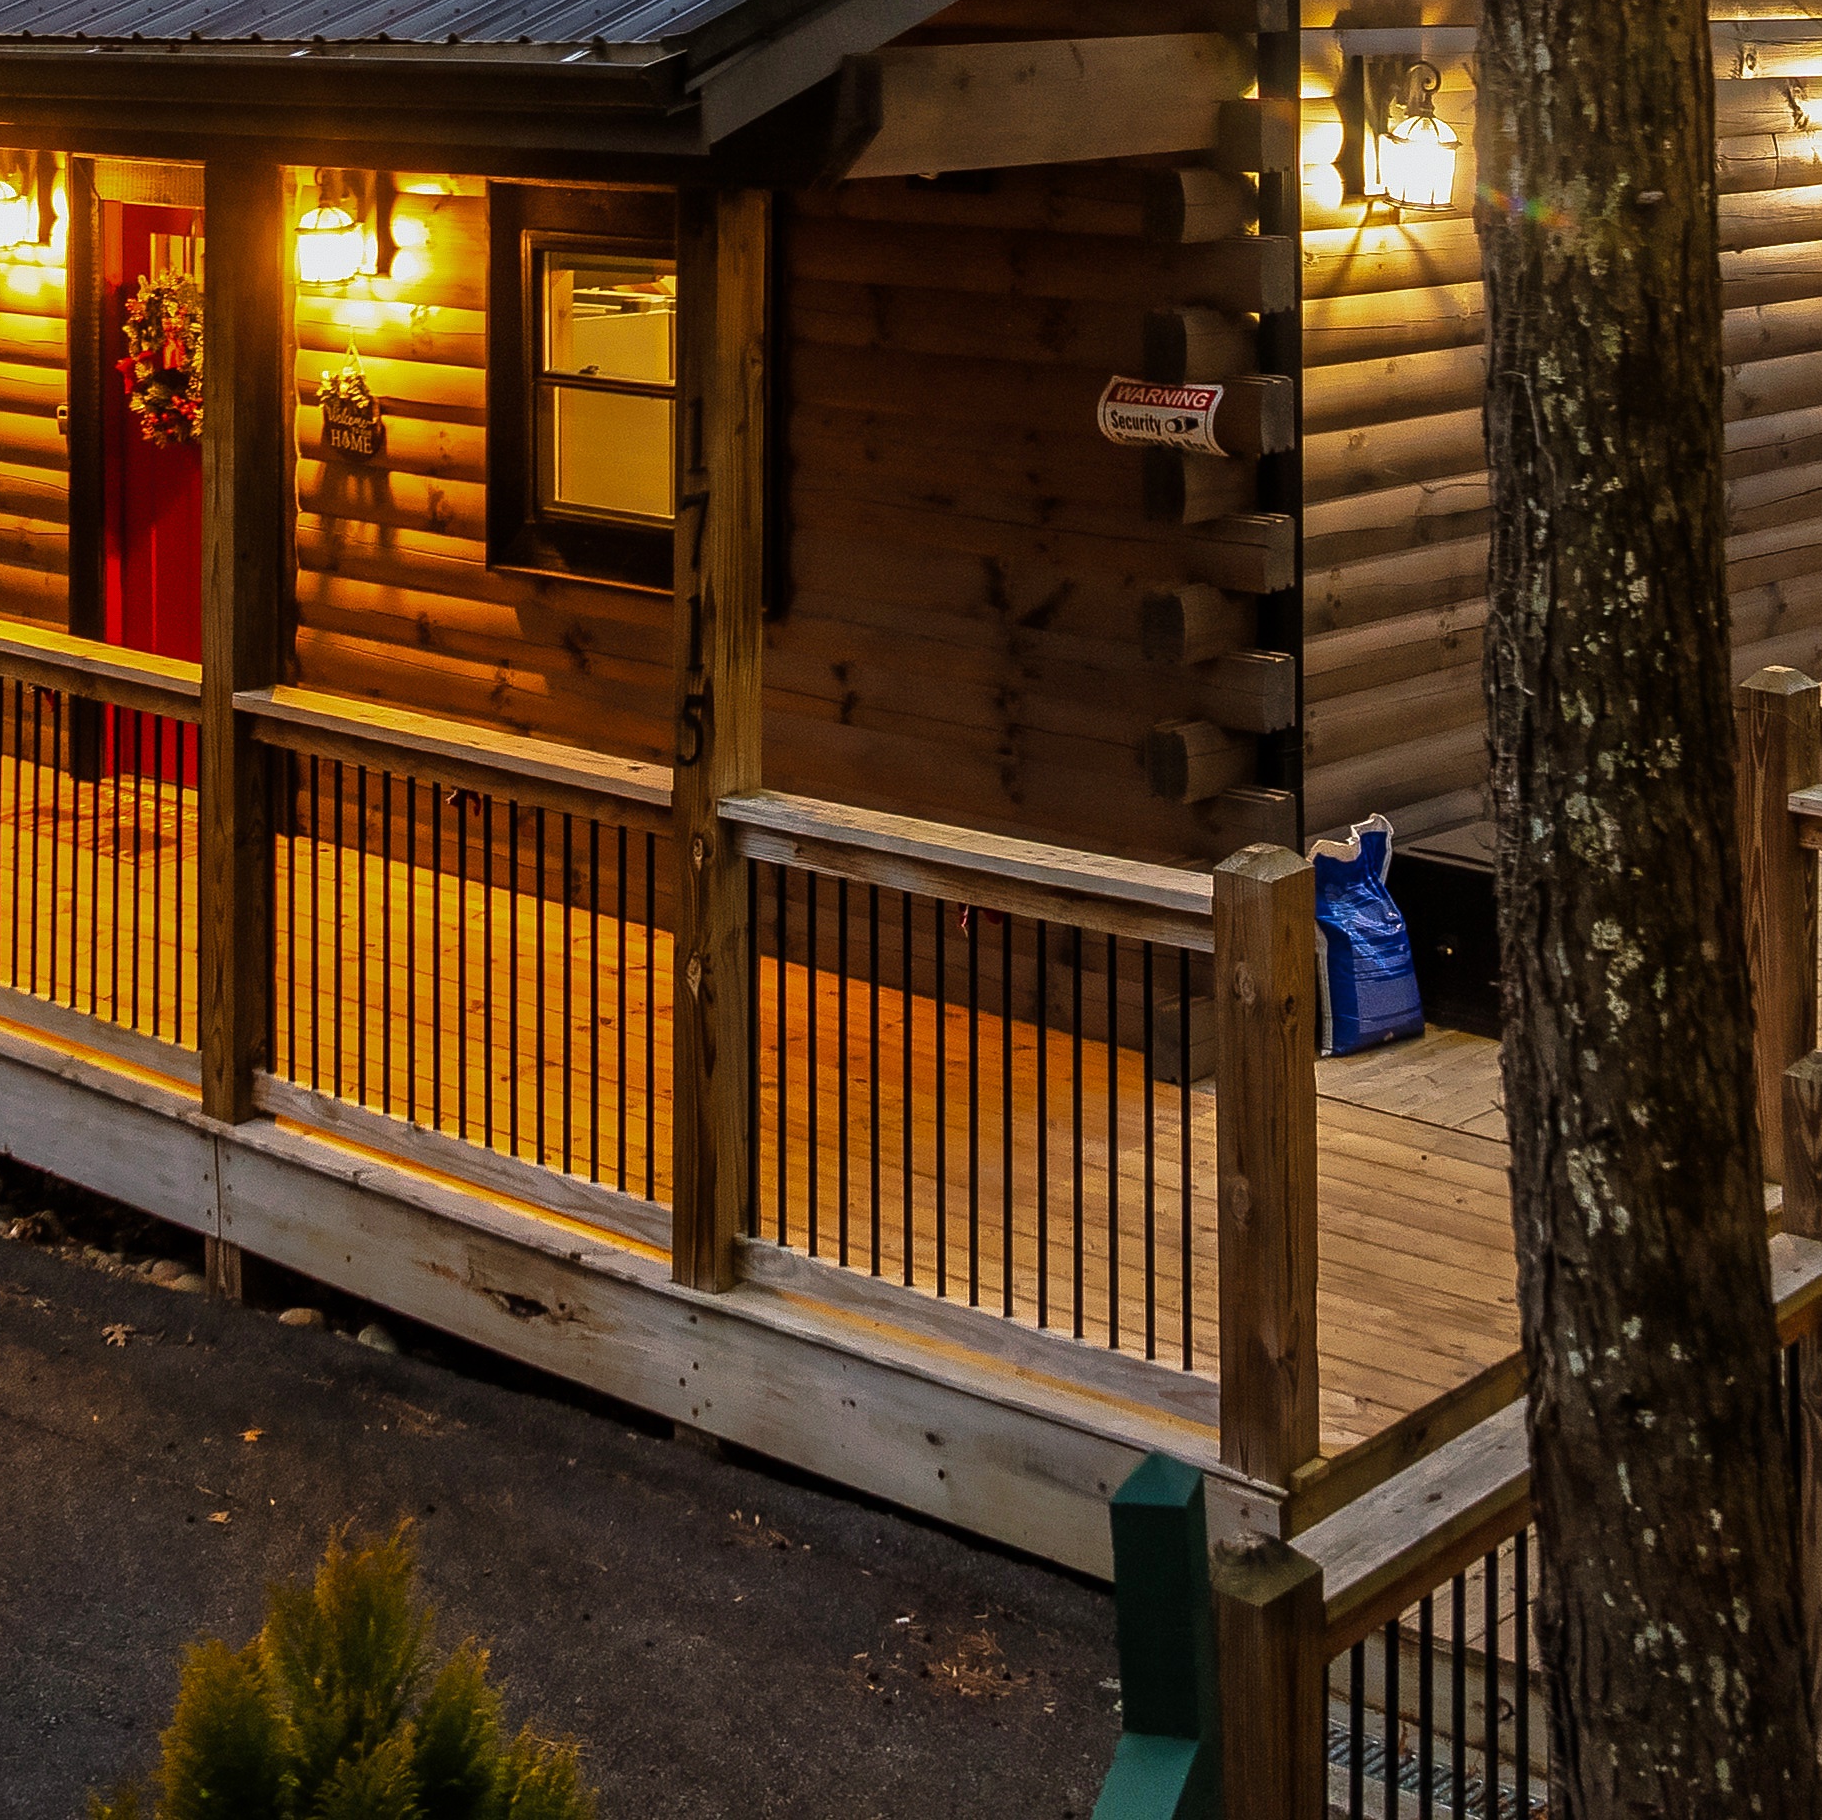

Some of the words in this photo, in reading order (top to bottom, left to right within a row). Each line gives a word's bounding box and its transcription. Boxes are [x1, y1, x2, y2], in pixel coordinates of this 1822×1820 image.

[1116, 385, 1210, 408] WARNING
[1110, 410, 1161, 436] Security
[331, 428, 373, 454] HOME
[677, 396, 710, 767] 1715
